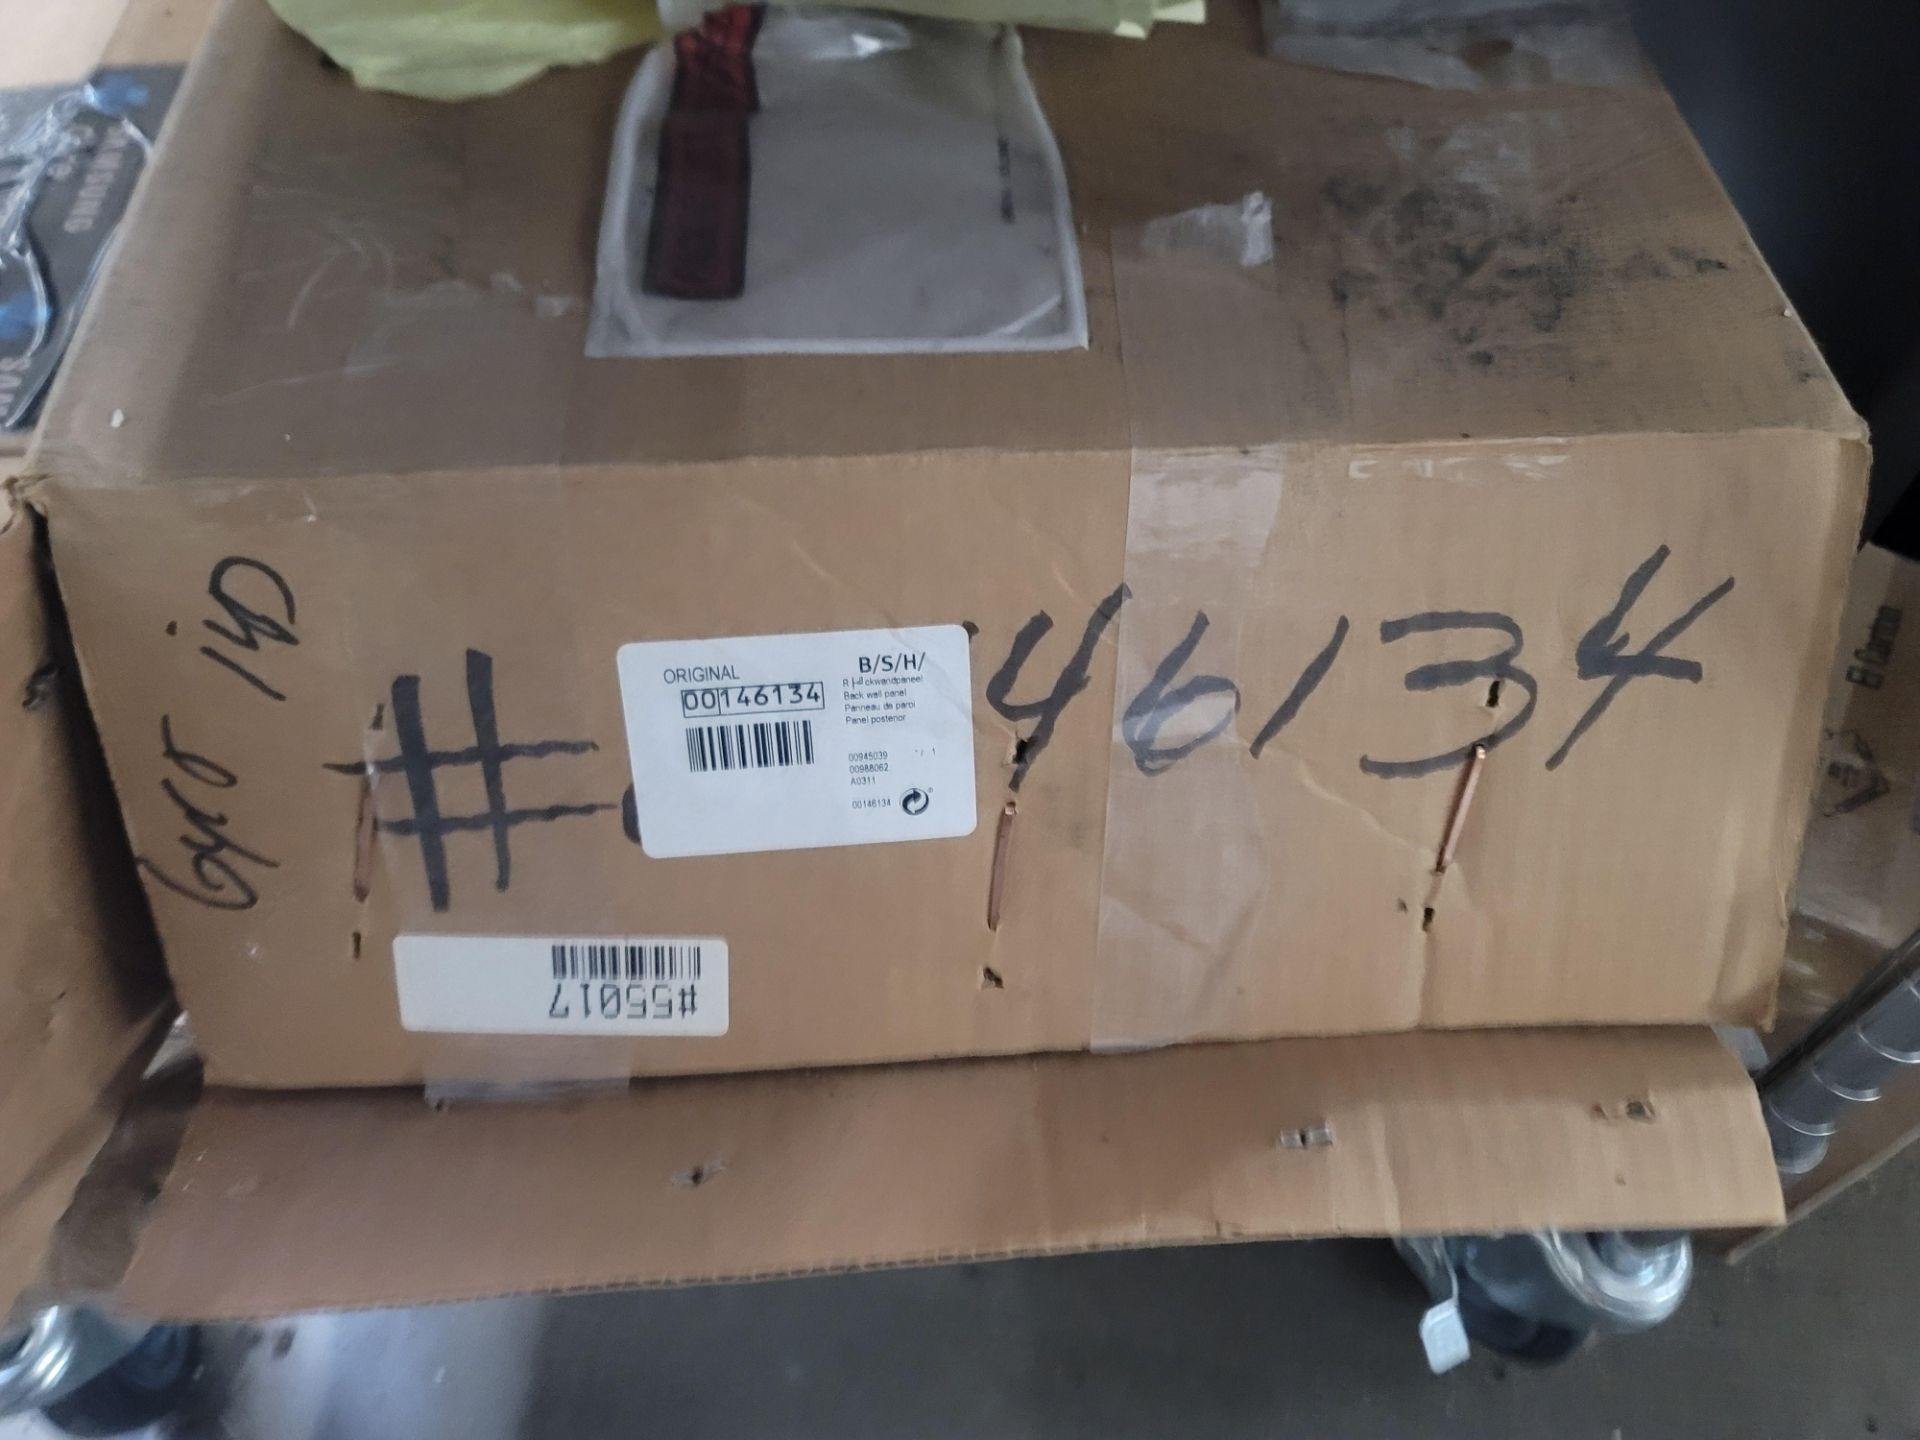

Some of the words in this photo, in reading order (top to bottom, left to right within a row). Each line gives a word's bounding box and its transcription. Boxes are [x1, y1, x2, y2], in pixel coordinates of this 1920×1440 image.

[858, 651, 926, 675] B/S/H/
[663, 665, 741, 684] ORIGINAL
[843, 691, 864, 701] Back
[884, 688, 907, 699] panel
[845, 715, 869, 725] Panel
[848, 750, 888, 762] 00945039
[850, 776, 876, 785] A0311
[549, 983, 698, 1019] #55017
